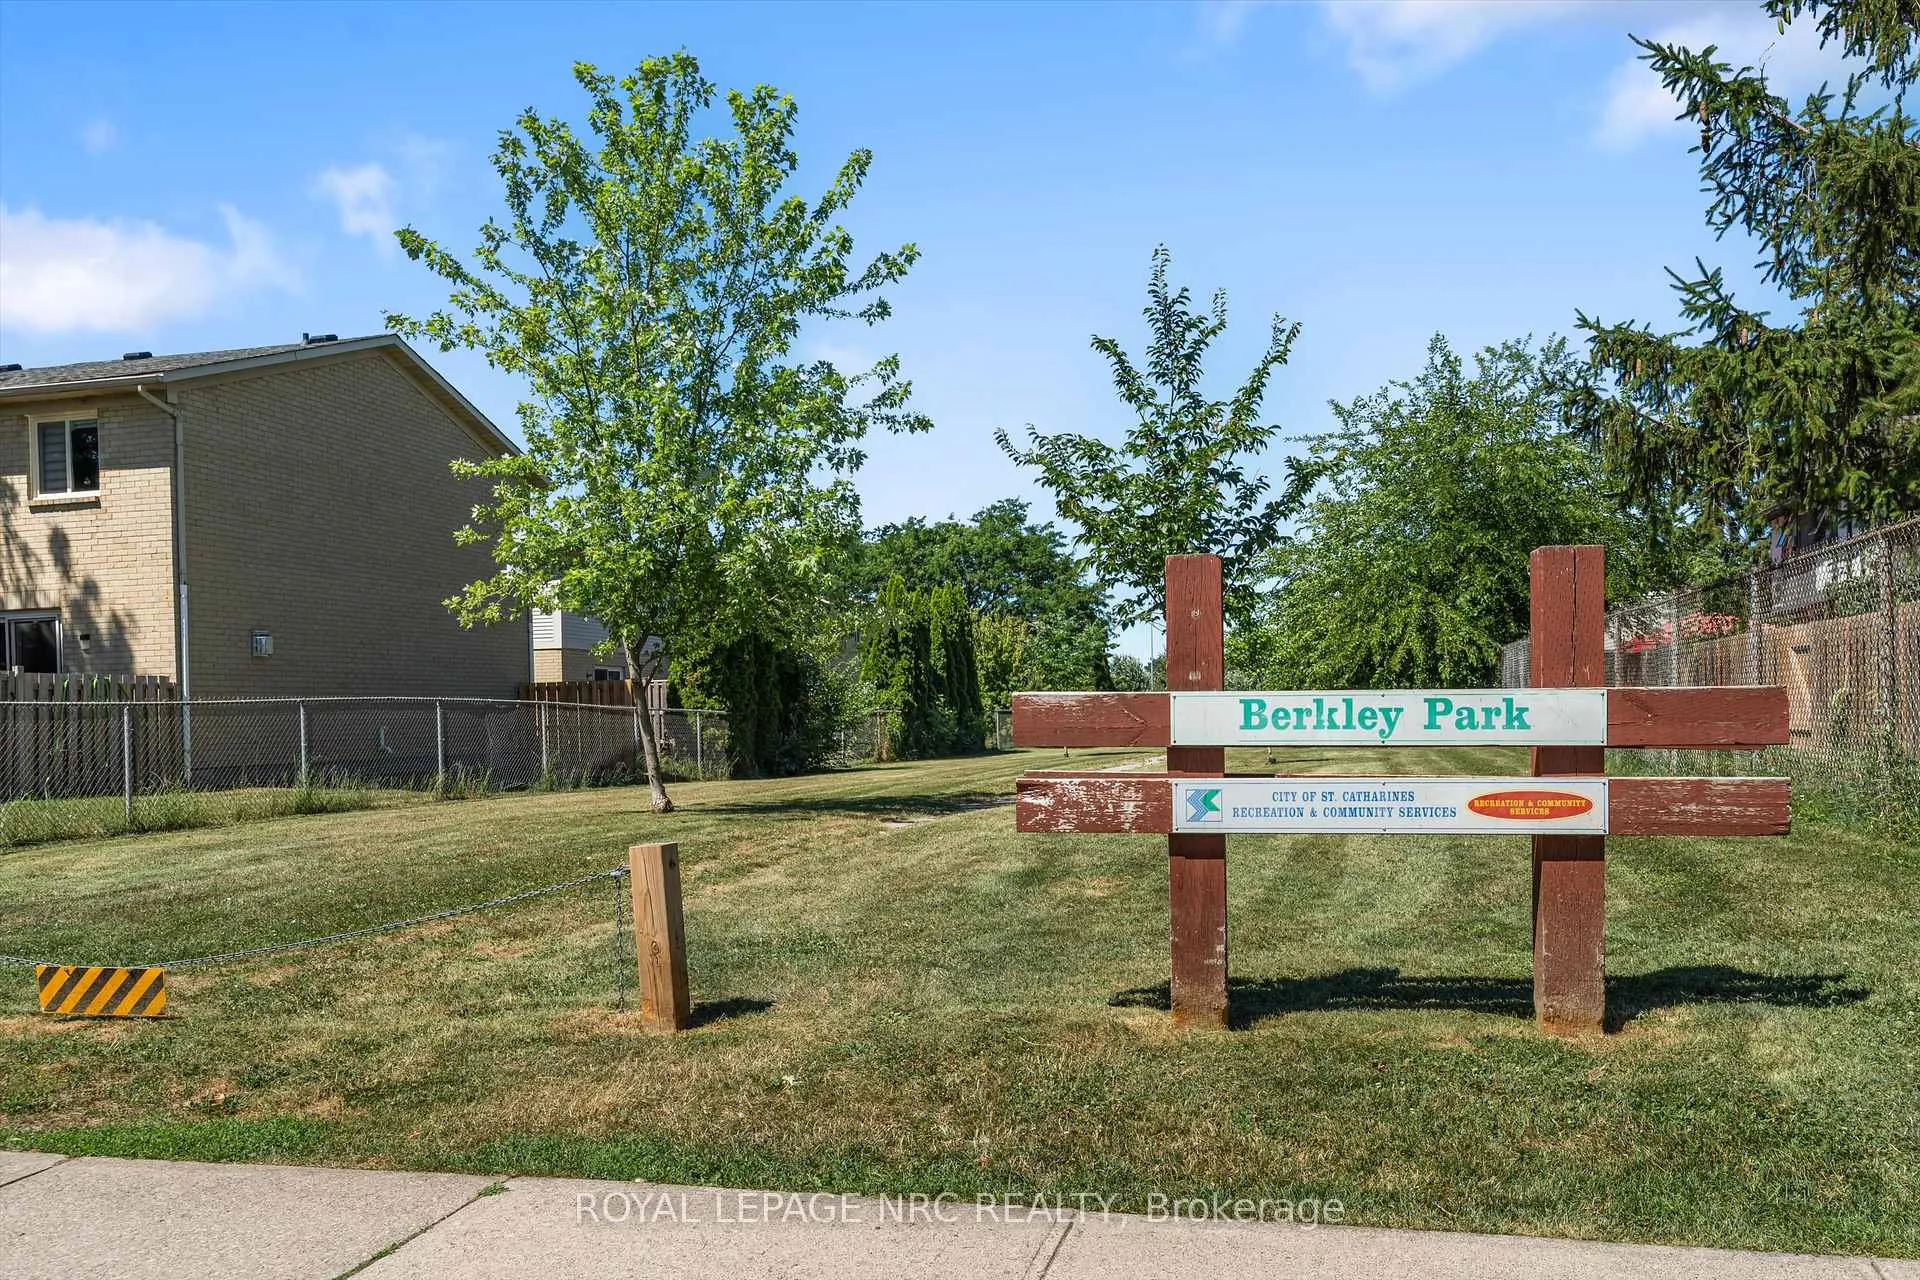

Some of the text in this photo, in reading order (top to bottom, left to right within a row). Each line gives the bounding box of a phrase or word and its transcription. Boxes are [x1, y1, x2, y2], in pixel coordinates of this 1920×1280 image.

[1239, 698, 1531, 739] Berkley Park
[1272, 791, 1415, 802] CITY OF ST. CATHARINES
[1474, 799, 1586, 807] RECREATION & COMMUNITY
[1232, 807, 1457, 818] RECREATION & COMMUNITY SERVICES
[1510, 807, 1550, 816] SERVICES
